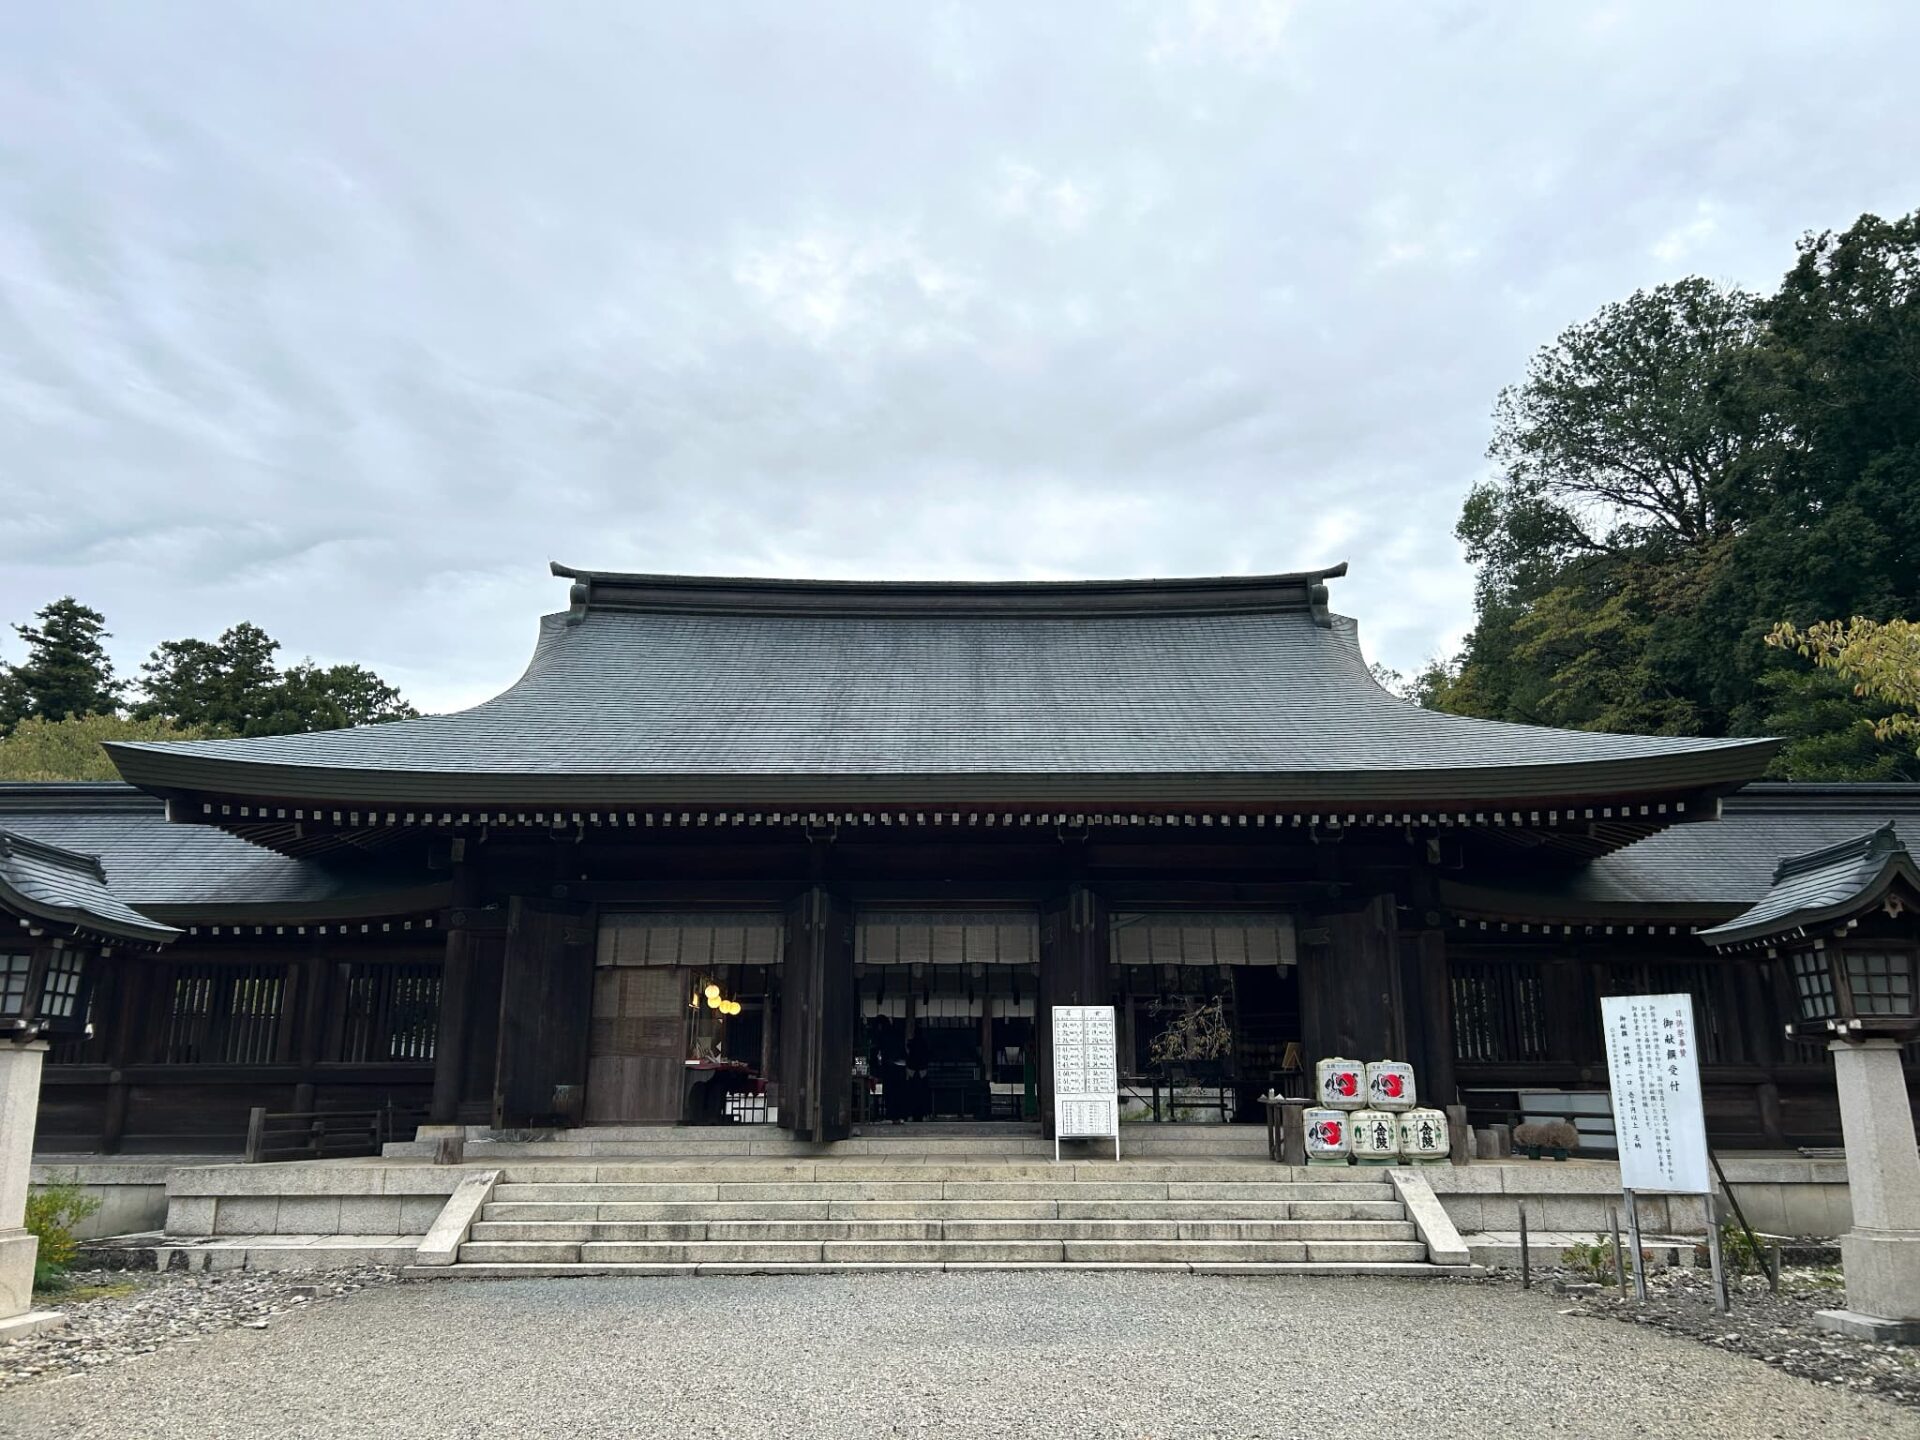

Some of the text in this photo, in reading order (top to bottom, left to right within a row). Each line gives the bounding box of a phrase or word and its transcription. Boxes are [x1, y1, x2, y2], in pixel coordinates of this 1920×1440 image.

[1663, 1017, 1680, 1091] 御献饌受付
